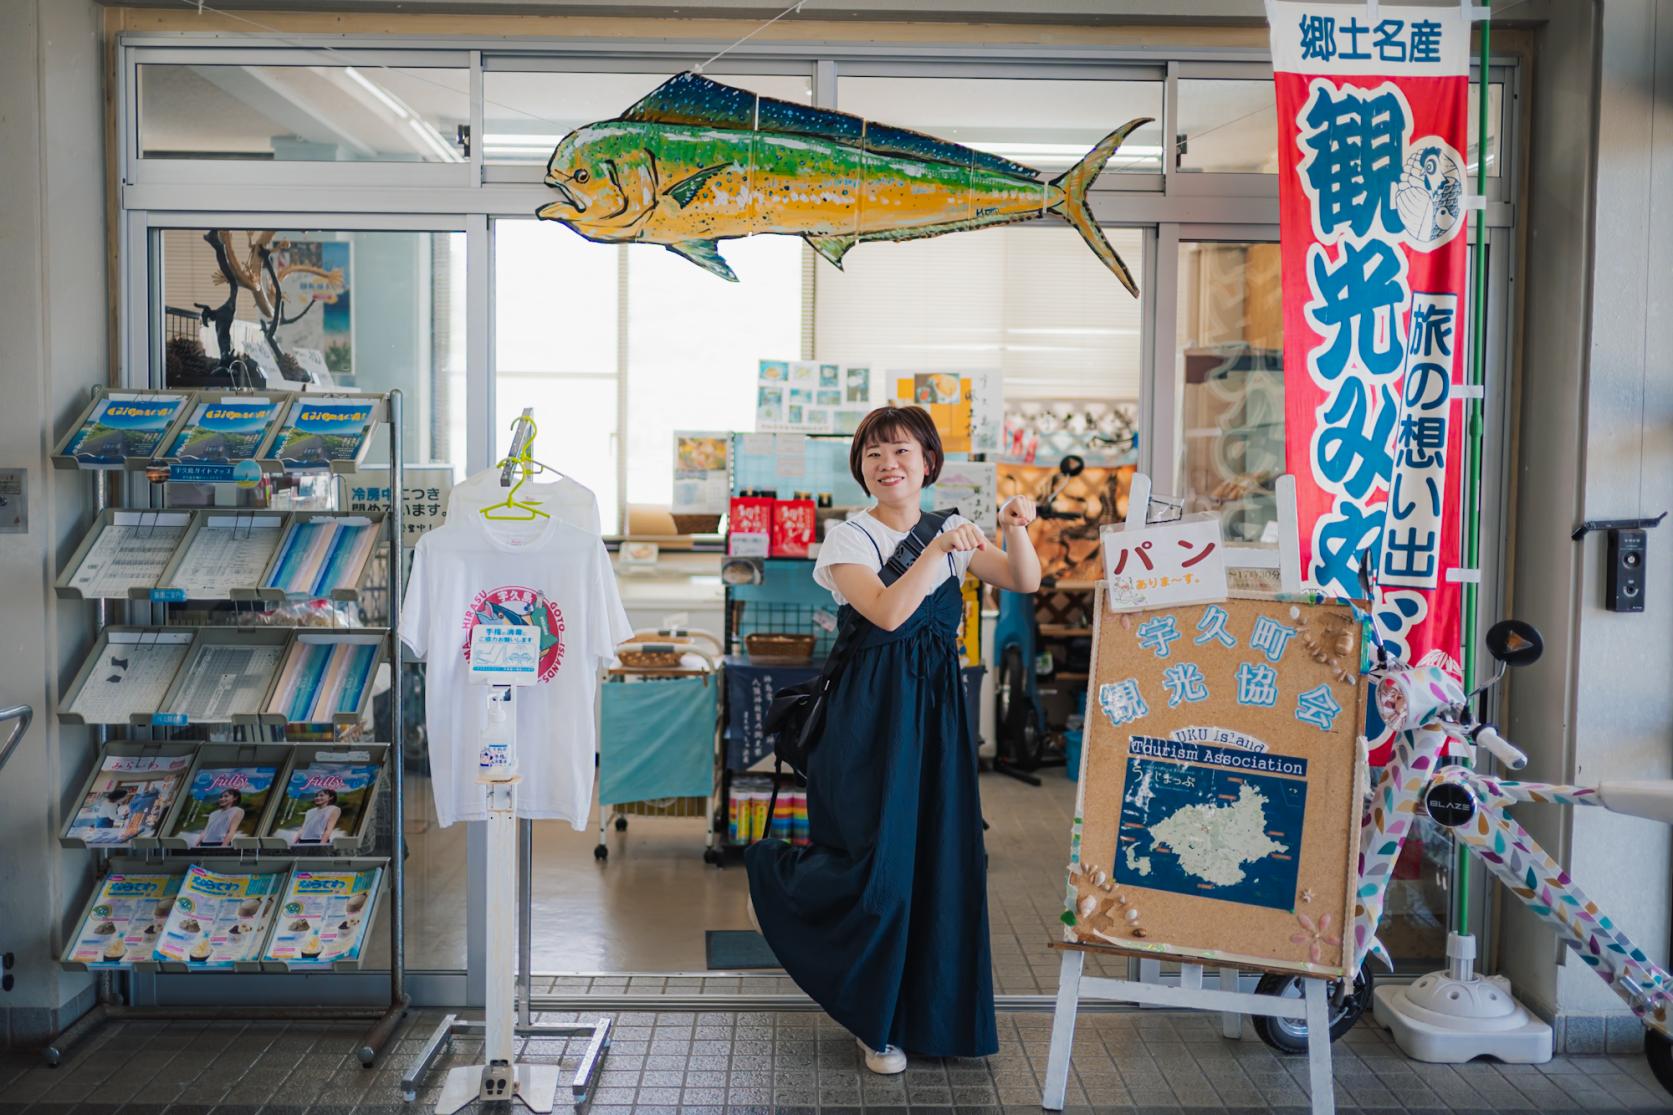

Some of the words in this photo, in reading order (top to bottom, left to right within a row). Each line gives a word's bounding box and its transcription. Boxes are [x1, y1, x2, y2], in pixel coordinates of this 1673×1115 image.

[1299, 13, 1442, 63] 郷土名産
[1384, 303, 1454, 578] 旅の想い出
[1113, 540, 1216, 575] パン
[549, 602, 565, 632] GOTO
[1137, 605, 1297, 662] 宇久町
[542, 643, 565, 683] ISLANDS
[1099, 662, 1342, 732] 観光協会
[1175, 728, 1208, 743] UKU
[1131, 739, 1199, 761] Tourism
[1203, 749, 1303, 775] Association
[1429, 800, 1471, 812] BLAZE
